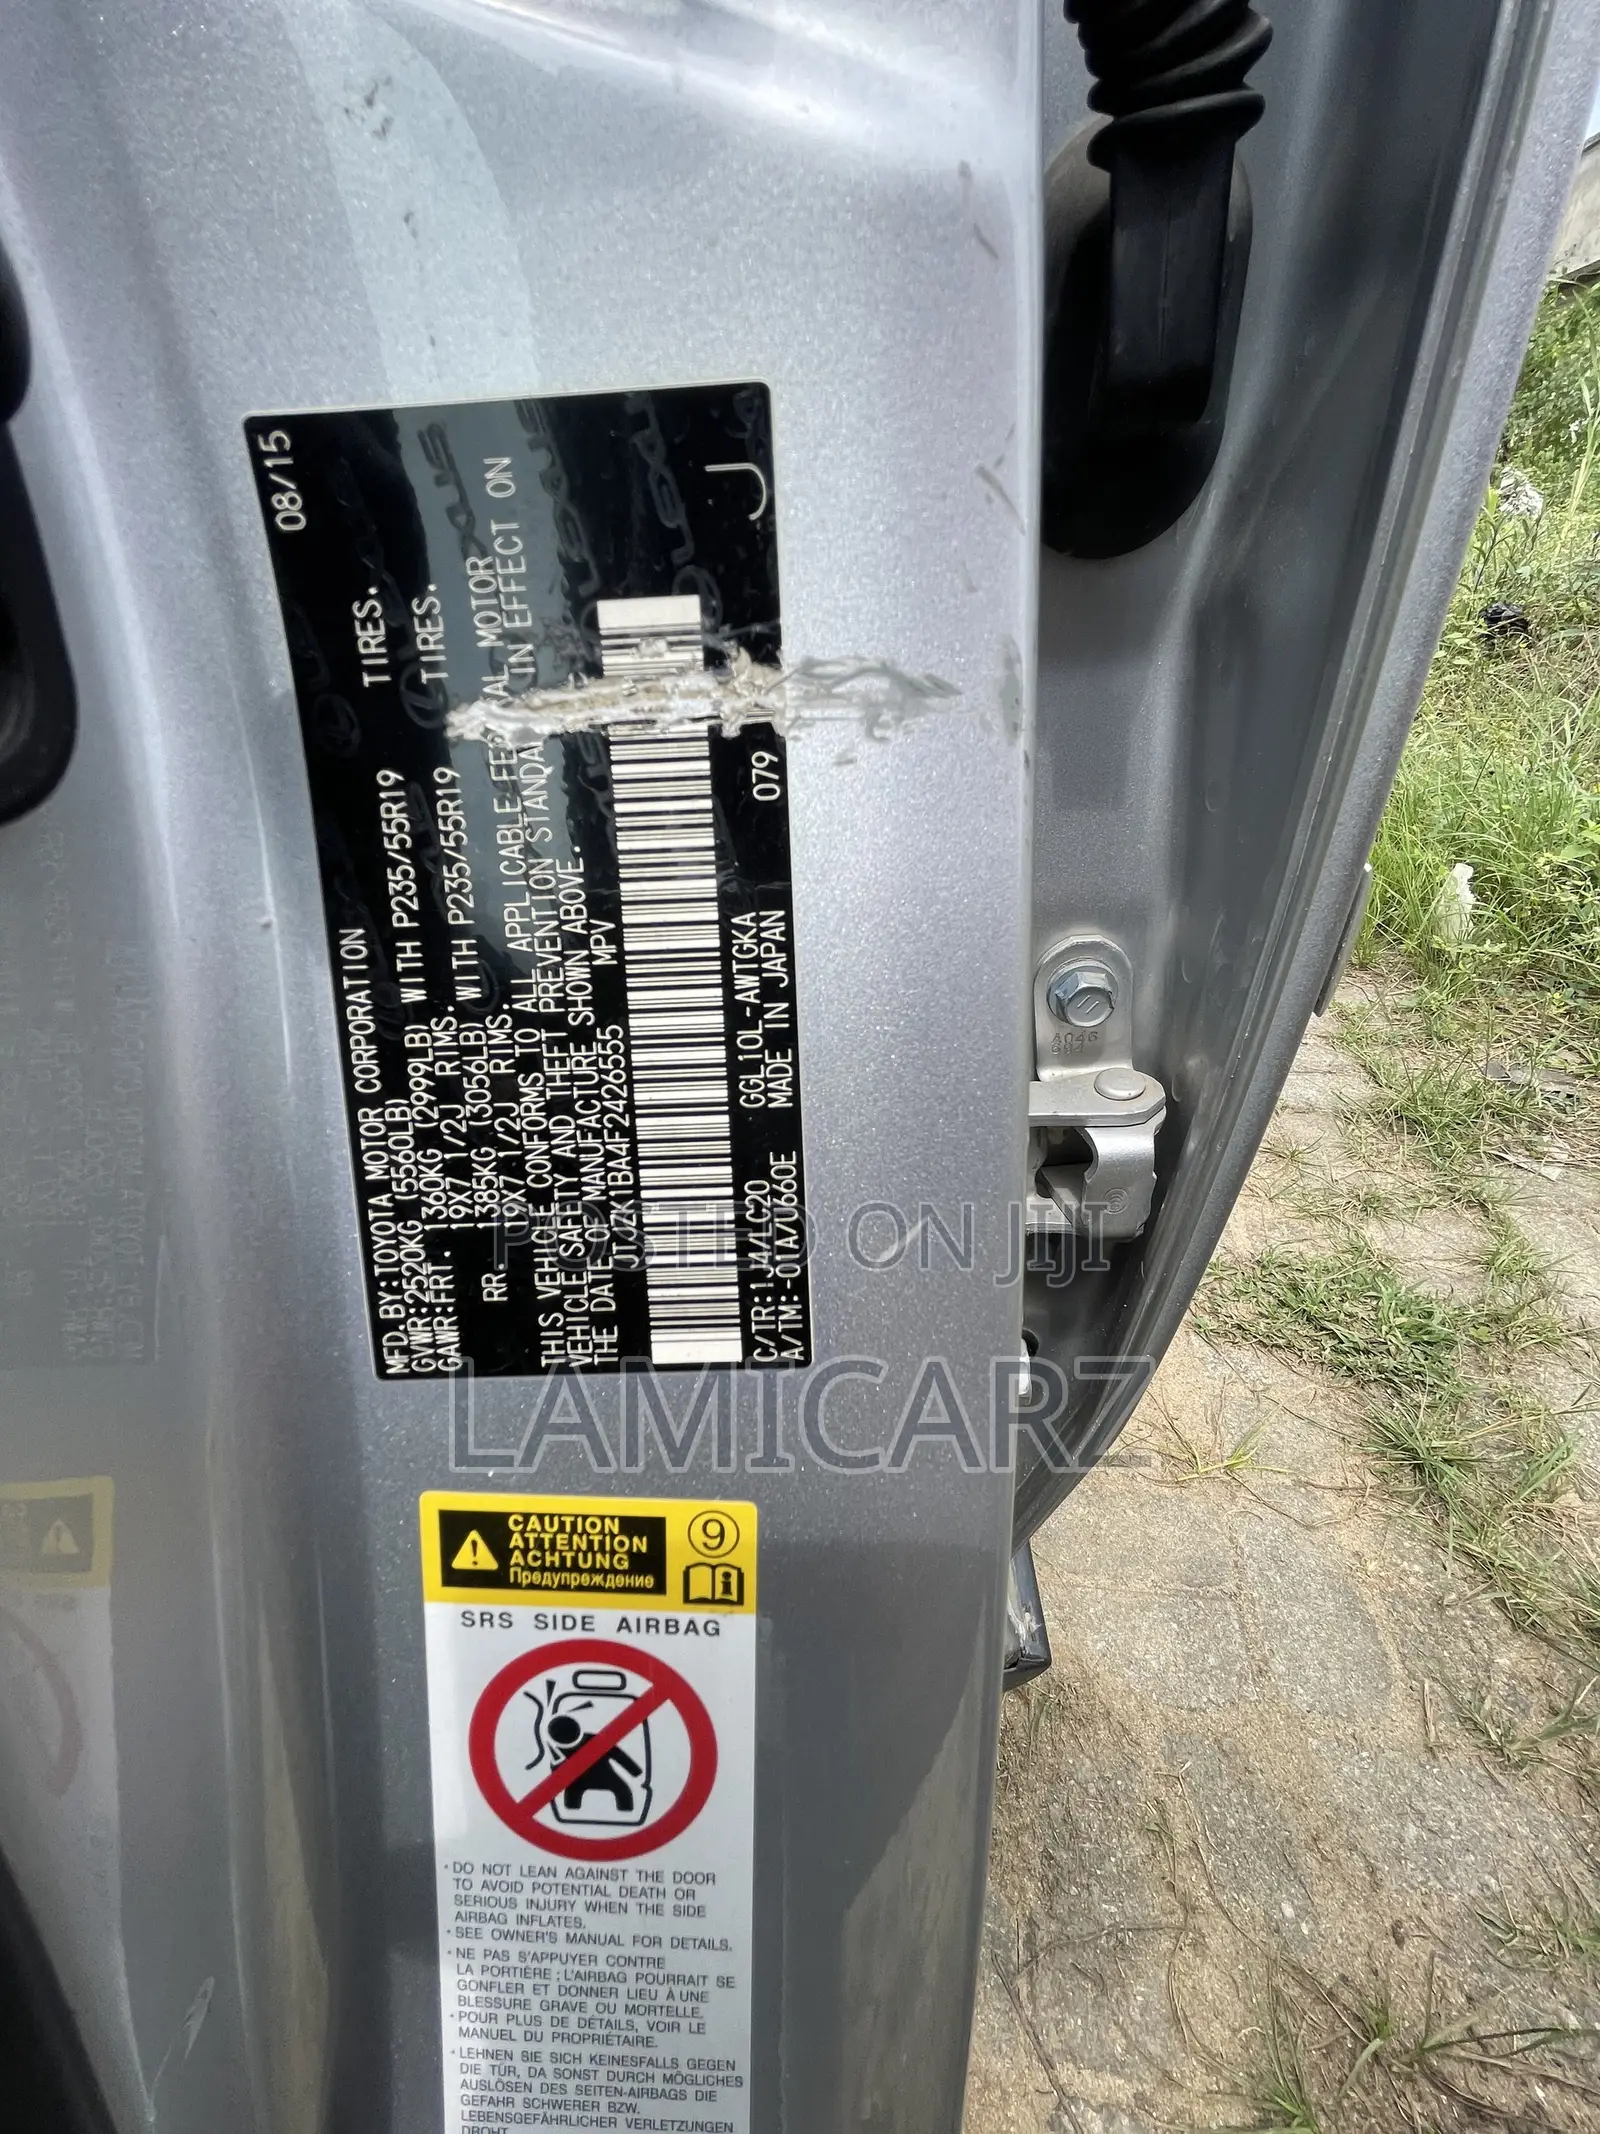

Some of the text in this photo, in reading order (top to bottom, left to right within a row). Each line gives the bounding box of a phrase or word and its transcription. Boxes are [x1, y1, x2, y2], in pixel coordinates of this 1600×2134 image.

[258, 430, 307, 532] 08/15
[704, 463, 767, 520] J
[352, 586, 391, 687] TIRES.
[752, 751, 780, 801] 079
[376, 769, 420, 927] P235/55R19
[483, 457, 594, 1366] VEHICLE SAFETY AND THEFT PREVENTION STANDA IN EFFECT ON
[411, 584, 508, 1302] RR. 1385KG (3056LB) WITH P235/55R19 TIRES.
[759, 910, 789, 987] JAPAN
[396, 941, 427, 1003] WITH
[465, 556, 566, 1368] THIS VEHICLE CONFORMS TO ALL APPLICABLE FEAL MOTOR
[339, 928, 382, 1093] CORPORATION
[731, 912, 766, 1108] GGL10L-AWTGKA
[763, 1002, 790, 1028] IN
[404, 1024, 438, 1128] (2999LB)
[764, 1048, 794, 1107] MADE
[556, 846, 619, 1366] THE DATE OF MANUFACTURE SHOWN ABOVE.
[590, 919, 639, 1268] JTJZK1BA4F2426555 MPV
[430, 1006, 476, 1230] 19X7 1/2J RIMS.
[486, 1004, 528, 1228] 19X7 1/2J RIMS.
[358, 1108, 390, 1180] MOTOR
[417, 1149, 448, 1230] 1360KG
[385, 1099, 436, 1372] GVWR:2520KG (5560LB)
[508, 1514, 619, 1534] CAUTION
[701, 1518, 725, 1550] 9
[509, 1532, 647, 1552] ATTENTION
[510, 1550, 629, 1569] ACHTUNG
[510, 1567, 654, 1590] Предупреждение
[461, 1611, 720, 1636] SRS SIDE AIRBAG
[453, 1861, 716, 1885] DO NOT LEAN AGAINST THE DOOR
[453, 1878, 695, 1900] TO AVOID POTENTIAL DEATH OR
[454, 1894, 706, 1918] SERIOUS INJURY WHEN THE SIDE
[455, 1911, 586, 1929] AIRBAG INFLATES.
[455, 1927, 732, 1951] SEE OWNER'S MANUAL FOR DETAILS.
[456, 1948, 665, 1969] NE PAS S'APPUYER CONTRE
[457, 1964, 474, 1975] LA
[564, 1969, 627, 1983] L'AIRBAG
[636, 1972, 708, 1986] POURRAIT
[716, 1975, 735, 1988] SE
[457, 1979, 525, 1994] GONFLER
[533, 1984, 550, 1995] ET
[558, 1985, 618, 1999] DONNER
[627, 1988, 658, 2000] LIEU
[680, 1991, 708, 2003] UNE
[458, 1995, 703, 2019] BLESSURE GRAVE OU MORTELLE.
[458, 2011, 498, 2024] POUR
[507, 2013, 542, 2027] PLUS
[551, 2016, 569, 2028] DE
[647, 2021, 681, 2033] VOIR
[689, 2022, 706, 2035] LE
[458, 2027, 516, 2041] MANUEL
[524, 2031, 543, 2043] DU
[460, 2047, 736, 2071] LEHNEN SIE SICH KEINESFALLS GEGEN
[460, 2063, 481, 2075] DIE
[528, 2067, 547, 2079] DA
[554, 2068, 600, 2081] SONST
[607, 2070, 655, 2083] DURCH
[461, 2094, 640, 2114] GEFAHR SCHWERER BZW.
[541, 2082, 568, 2095] DES
[575, 2085, 687, 2101] SEITEN-AIRBAGS
[695, 2090, 717, 2102] DIE
[625, 2117, 734, 2133] VERLETZUNGEN
